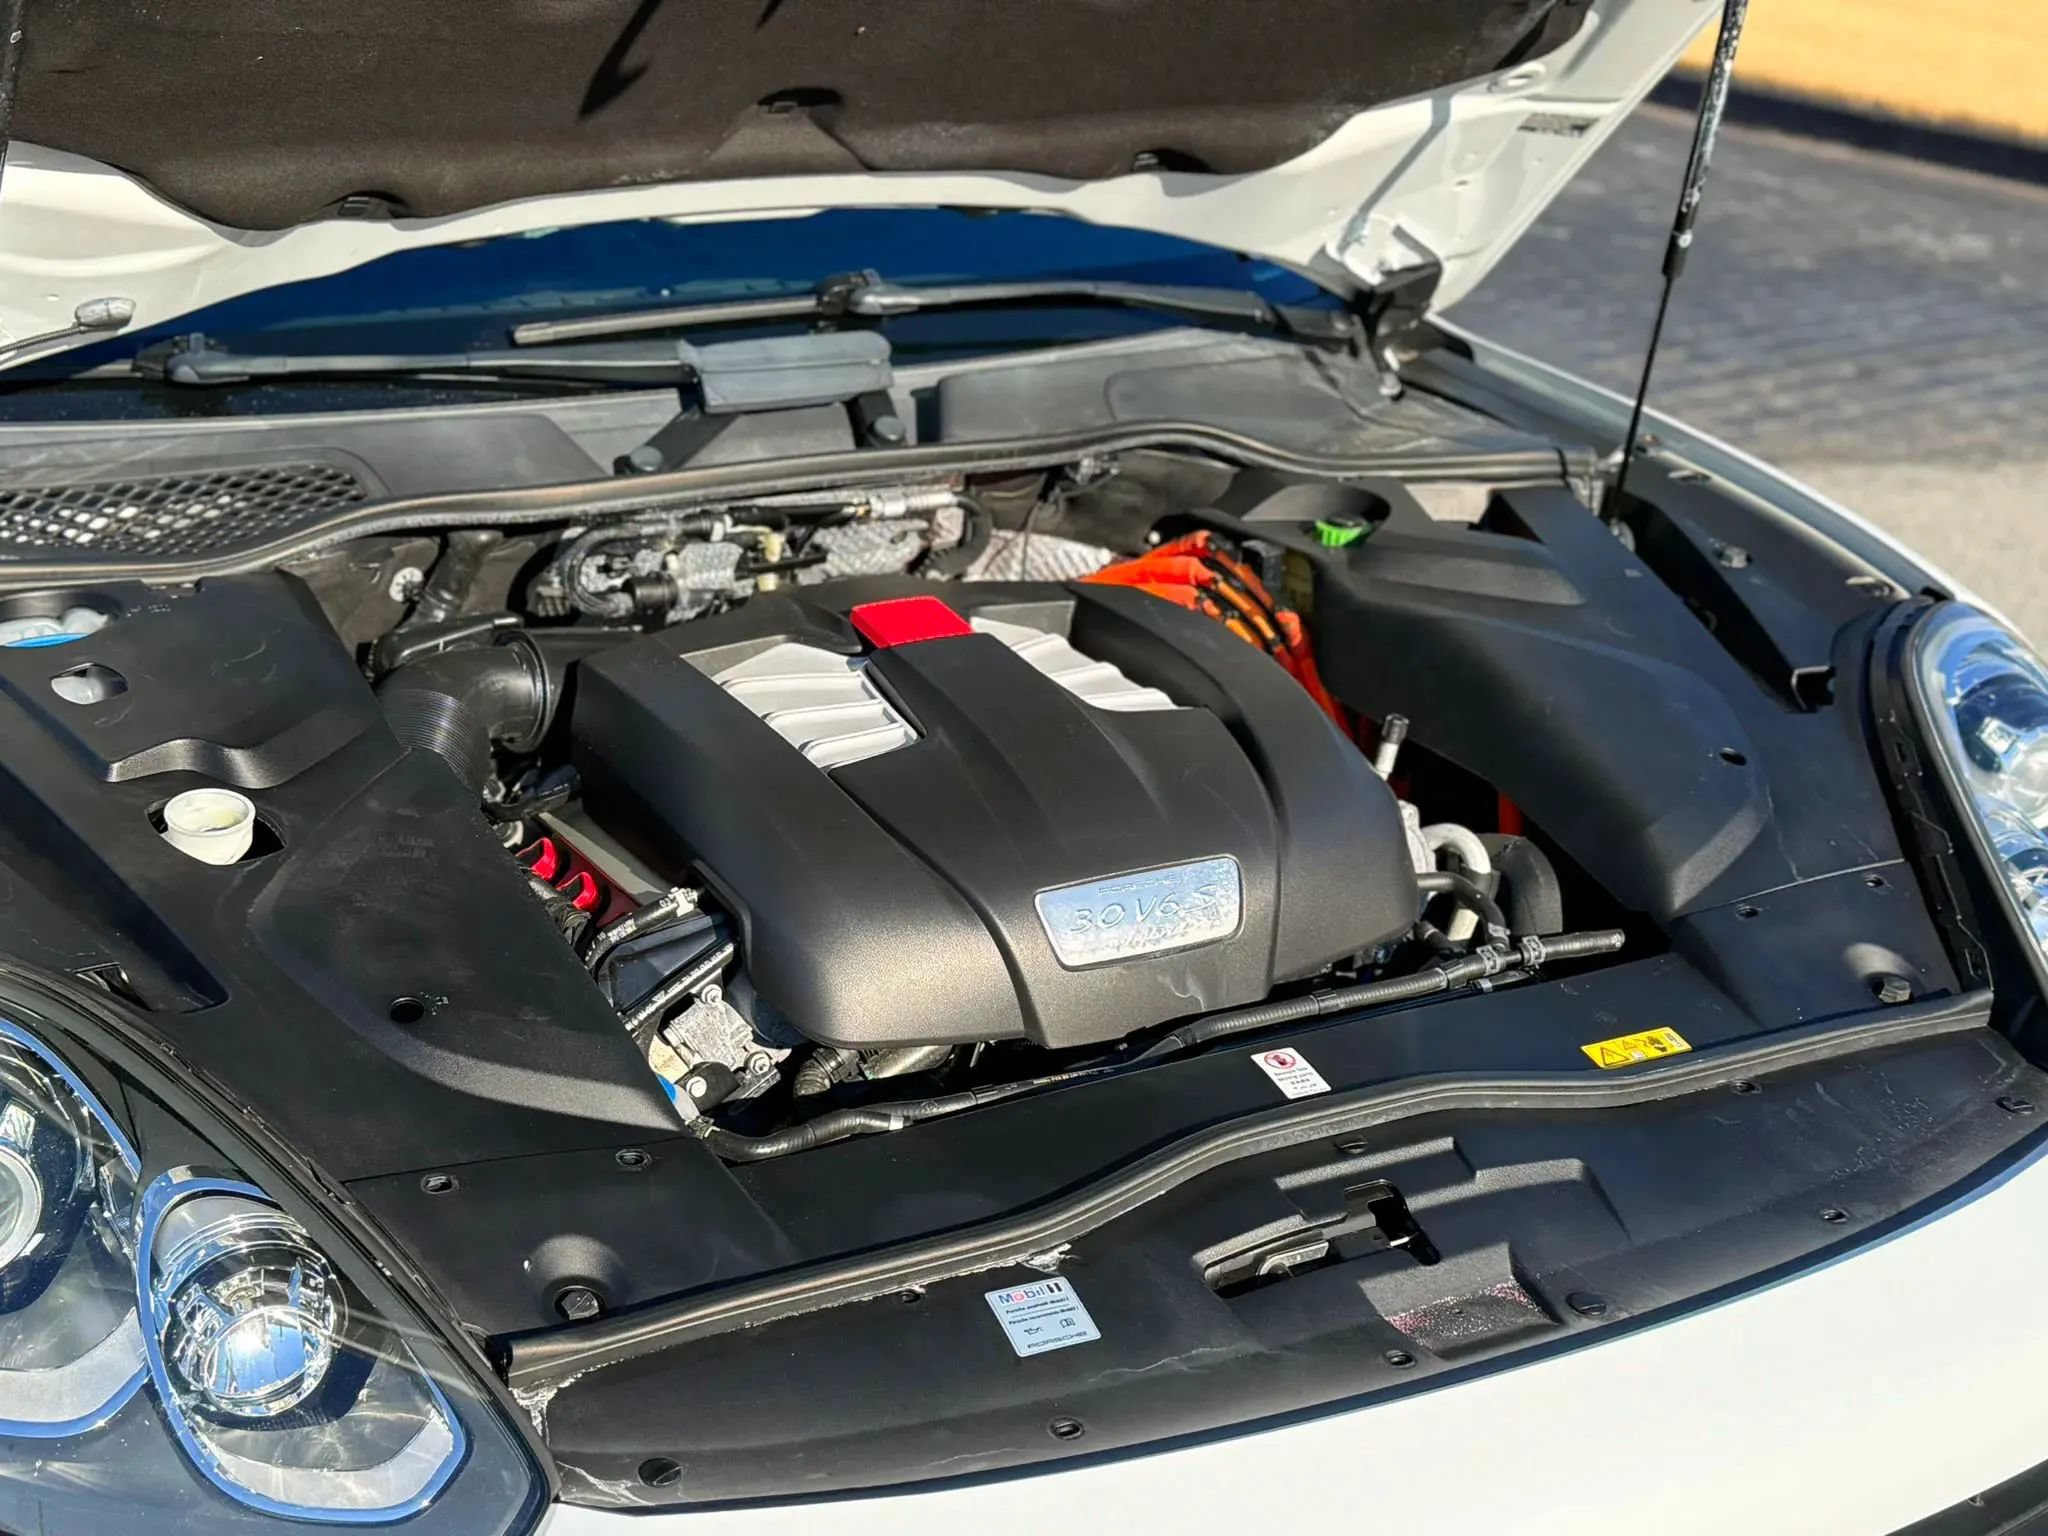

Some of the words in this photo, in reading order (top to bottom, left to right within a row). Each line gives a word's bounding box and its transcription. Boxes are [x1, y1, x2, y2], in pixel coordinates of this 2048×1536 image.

[1136, 892, 1180, 922] V6
[998, 1286, 1045, 1304] Mobil
[1027, 1331, 1088, 1348] PORSCHE
